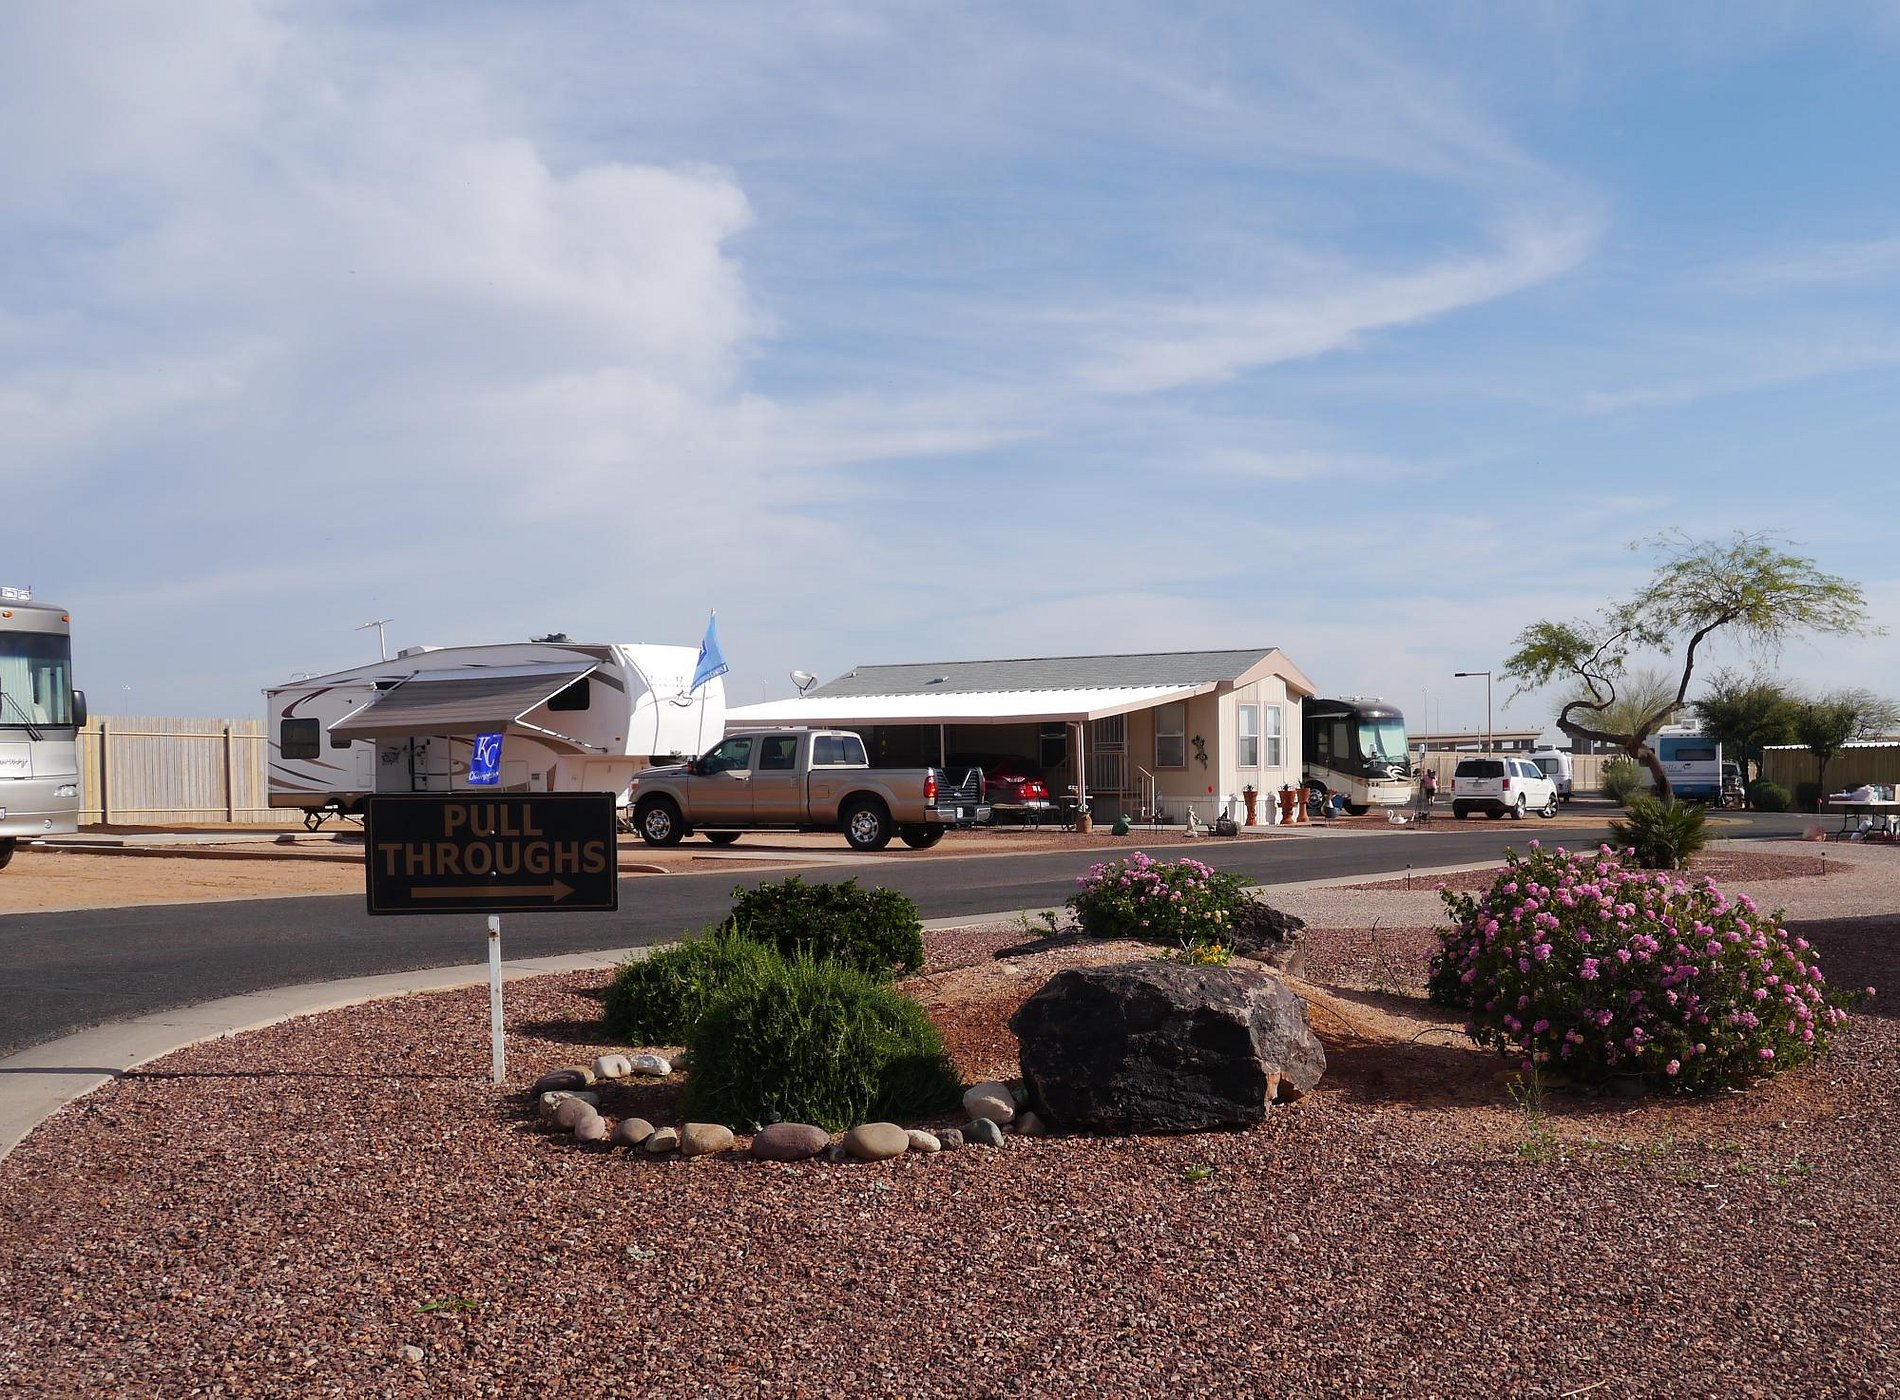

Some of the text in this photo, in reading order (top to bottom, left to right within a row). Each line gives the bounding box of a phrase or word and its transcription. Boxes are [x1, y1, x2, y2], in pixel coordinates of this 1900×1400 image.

[474, 736, 499, 768] KC
[443, 804, 543, 837] PULL
[378, 841, 606, 876] THROUGHS
